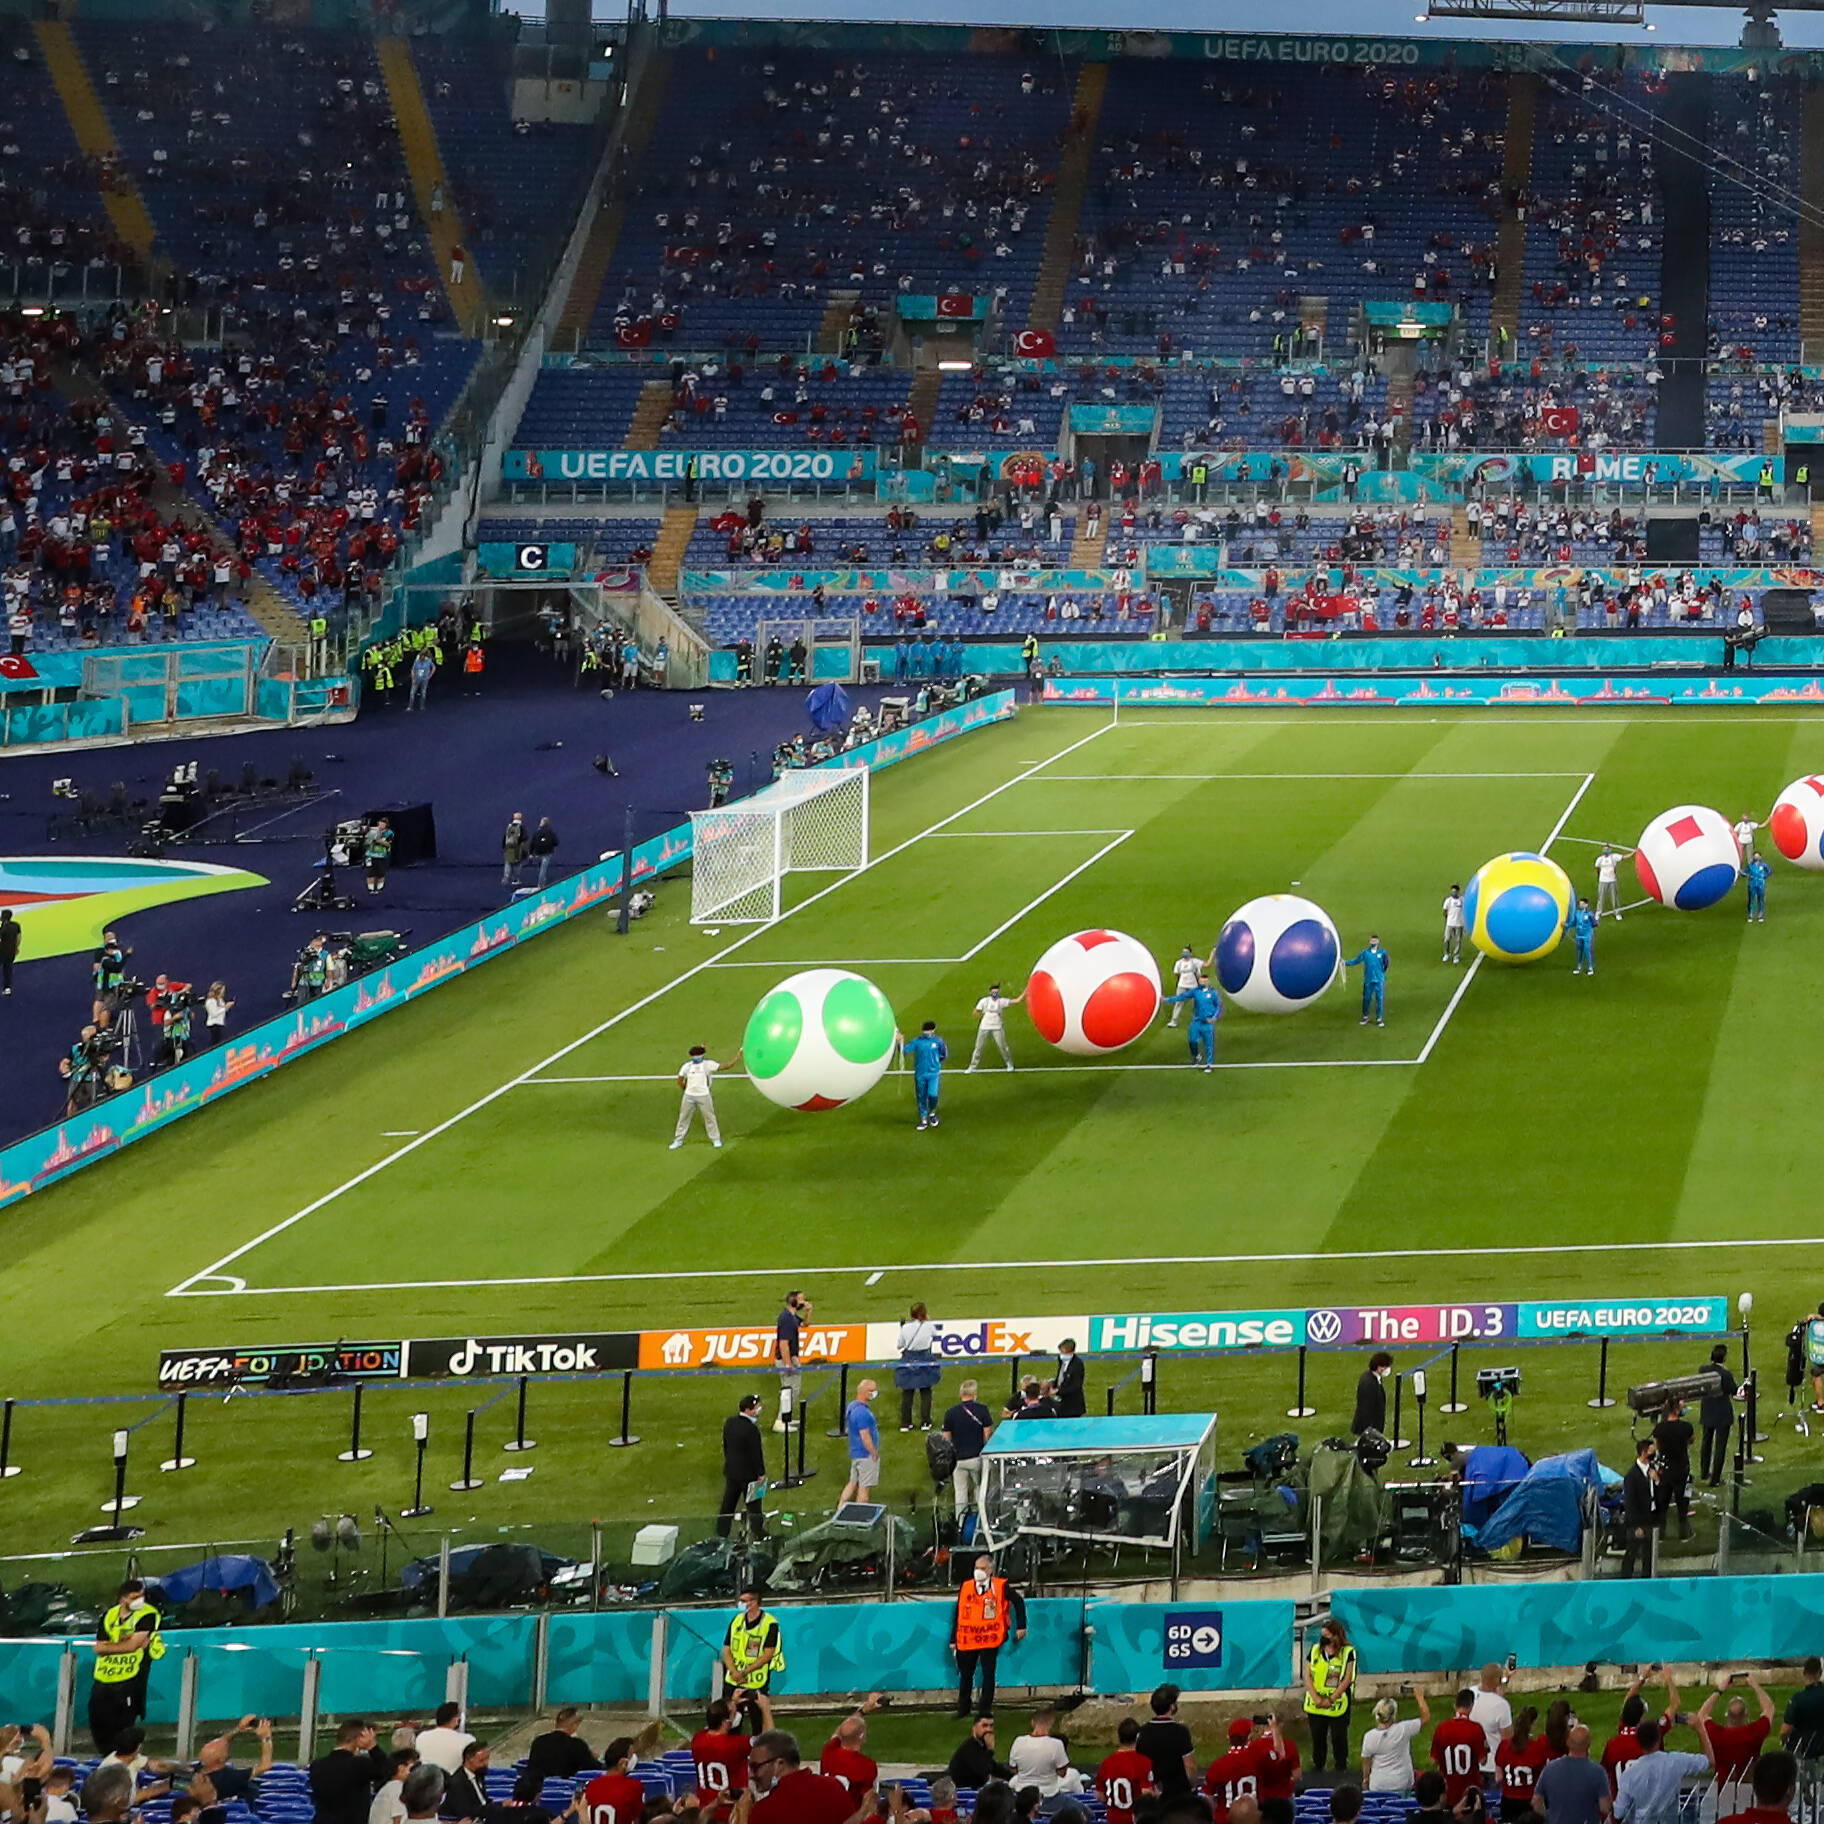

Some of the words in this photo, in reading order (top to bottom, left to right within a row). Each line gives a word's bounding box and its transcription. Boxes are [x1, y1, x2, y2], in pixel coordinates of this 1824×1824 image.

[1203, 38, 1272, 60] UEFA
[1279, 40, 1348, 62] EURO
[1352, 42, 1419, 64] 2020
[560, 452, 649, 478] UEFA
[750, 454, 834, 479] 2020
[1552, 457, 1640, 481] RME
[521, 546, 543, 569] C
[1358, 1311, 1420, 1340] The
[1439, 1307, 1504, 1339] ID.3
[1536, 1310, 1599, 1328] UEFA
[1600, 1308, 1654, 1327] EURO
[700, 1332, 777, 1363] JUST
[1100, 1317, 1294, 1351] Hisense
[159, 1357, 233, 1381] UEFA
[486, 1343, 598, 1373] TikTok
[1168, 1625, 1191, 1640] 6D
[1168, 1643, 1191, 1658] 6S
[1444, 1744, 1472, 1775] 10
[697, 1761, 730, 1791] 10
[1105, 1777, 1133, 1809] 10
